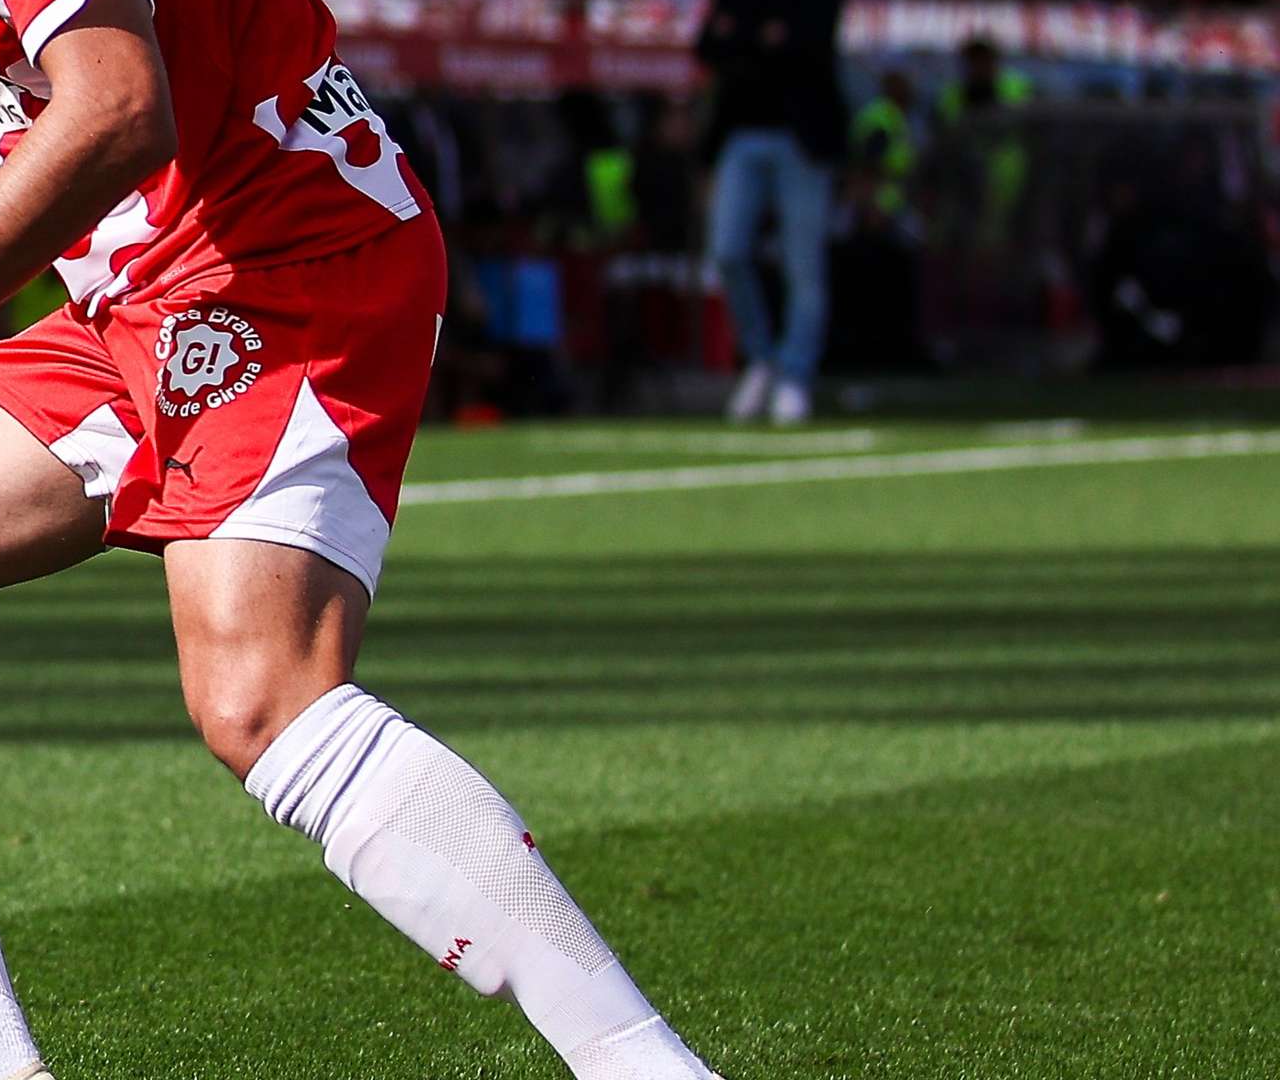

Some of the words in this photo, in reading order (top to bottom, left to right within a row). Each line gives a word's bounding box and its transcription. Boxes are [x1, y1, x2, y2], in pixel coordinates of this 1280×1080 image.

[154, 308, 202, 360] Costa
[208, 307, 263, 352] Brava
[181, 341, 222, 375] G!
[179, 401, 201, 417] de
[206, 362, 262, 409] Girona
